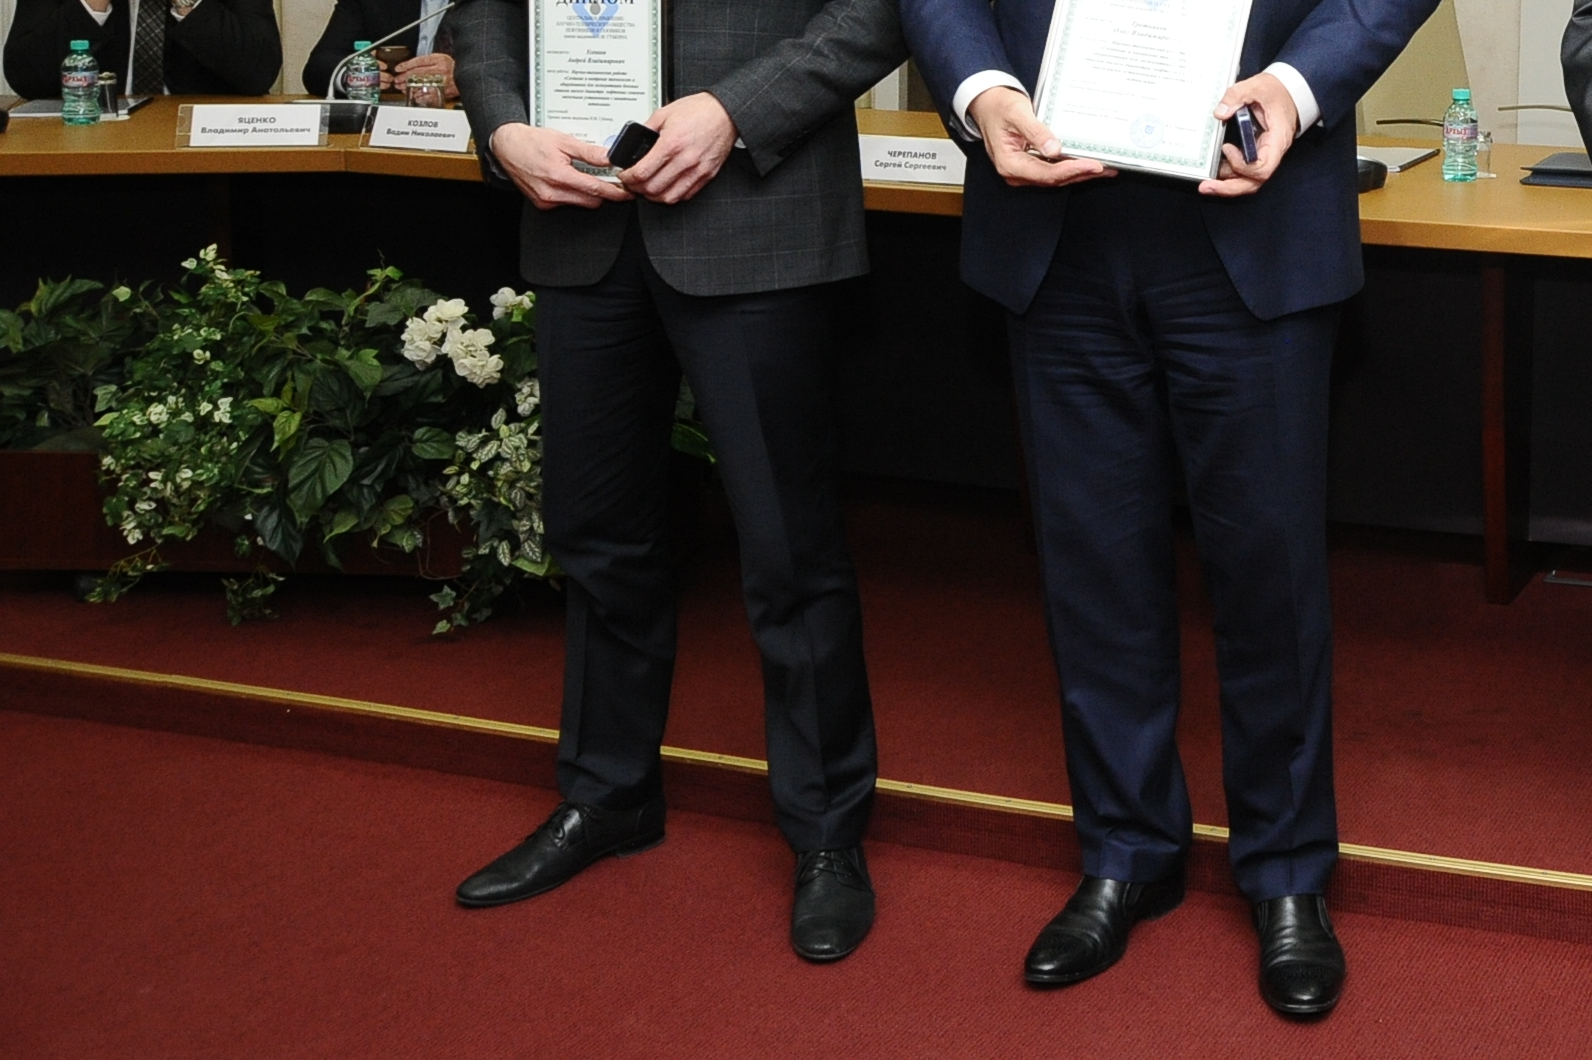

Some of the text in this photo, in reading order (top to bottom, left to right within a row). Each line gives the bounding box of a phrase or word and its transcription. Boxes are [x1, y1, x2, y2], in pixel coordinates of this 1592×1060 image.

[237, 116, 277, 124] ЯЦЕНКО
[407, 120, 439, 128] КОЗЛОВ
[200, 126, 311, 135] Владимир Анатольевич
[386, 128, 456, 138] Вадим Николаевич
[887, 150, 937, 160] ЧЕРЕПАНОВ
[874, 160, 947, 171] Сергей Сергеевич
